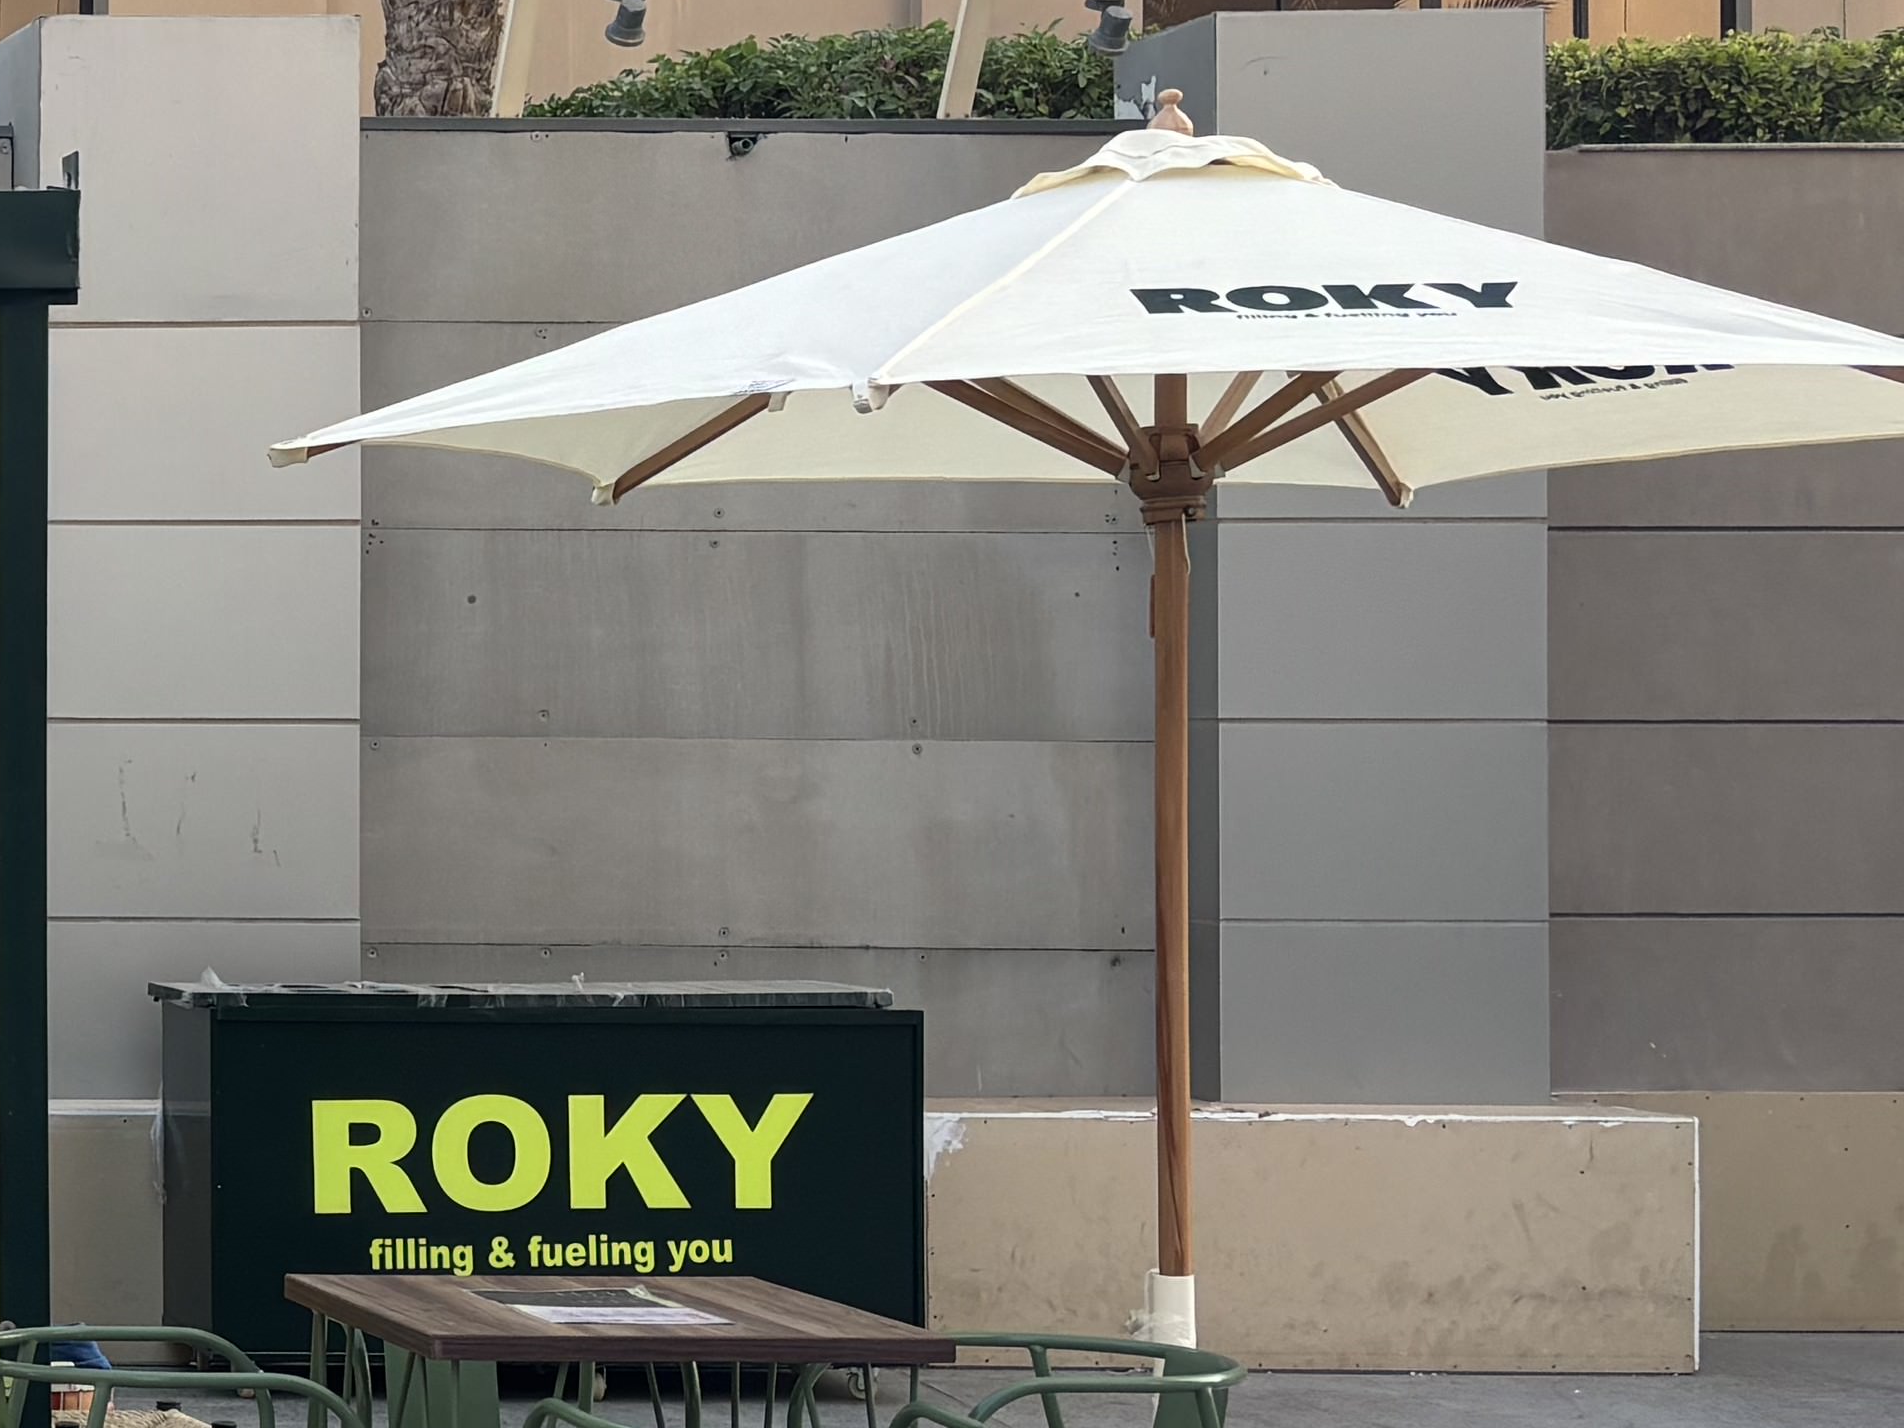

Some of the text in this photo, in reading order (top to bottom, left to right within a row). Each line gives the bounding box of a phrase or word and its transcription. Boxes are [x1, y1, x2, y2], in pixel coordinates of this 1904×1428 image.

[1129, 281, 1519, 314] ROKY
[311, 1093, 814, 1214] ROKY
[369, 1234, 734, 1276] filling & fueling you
